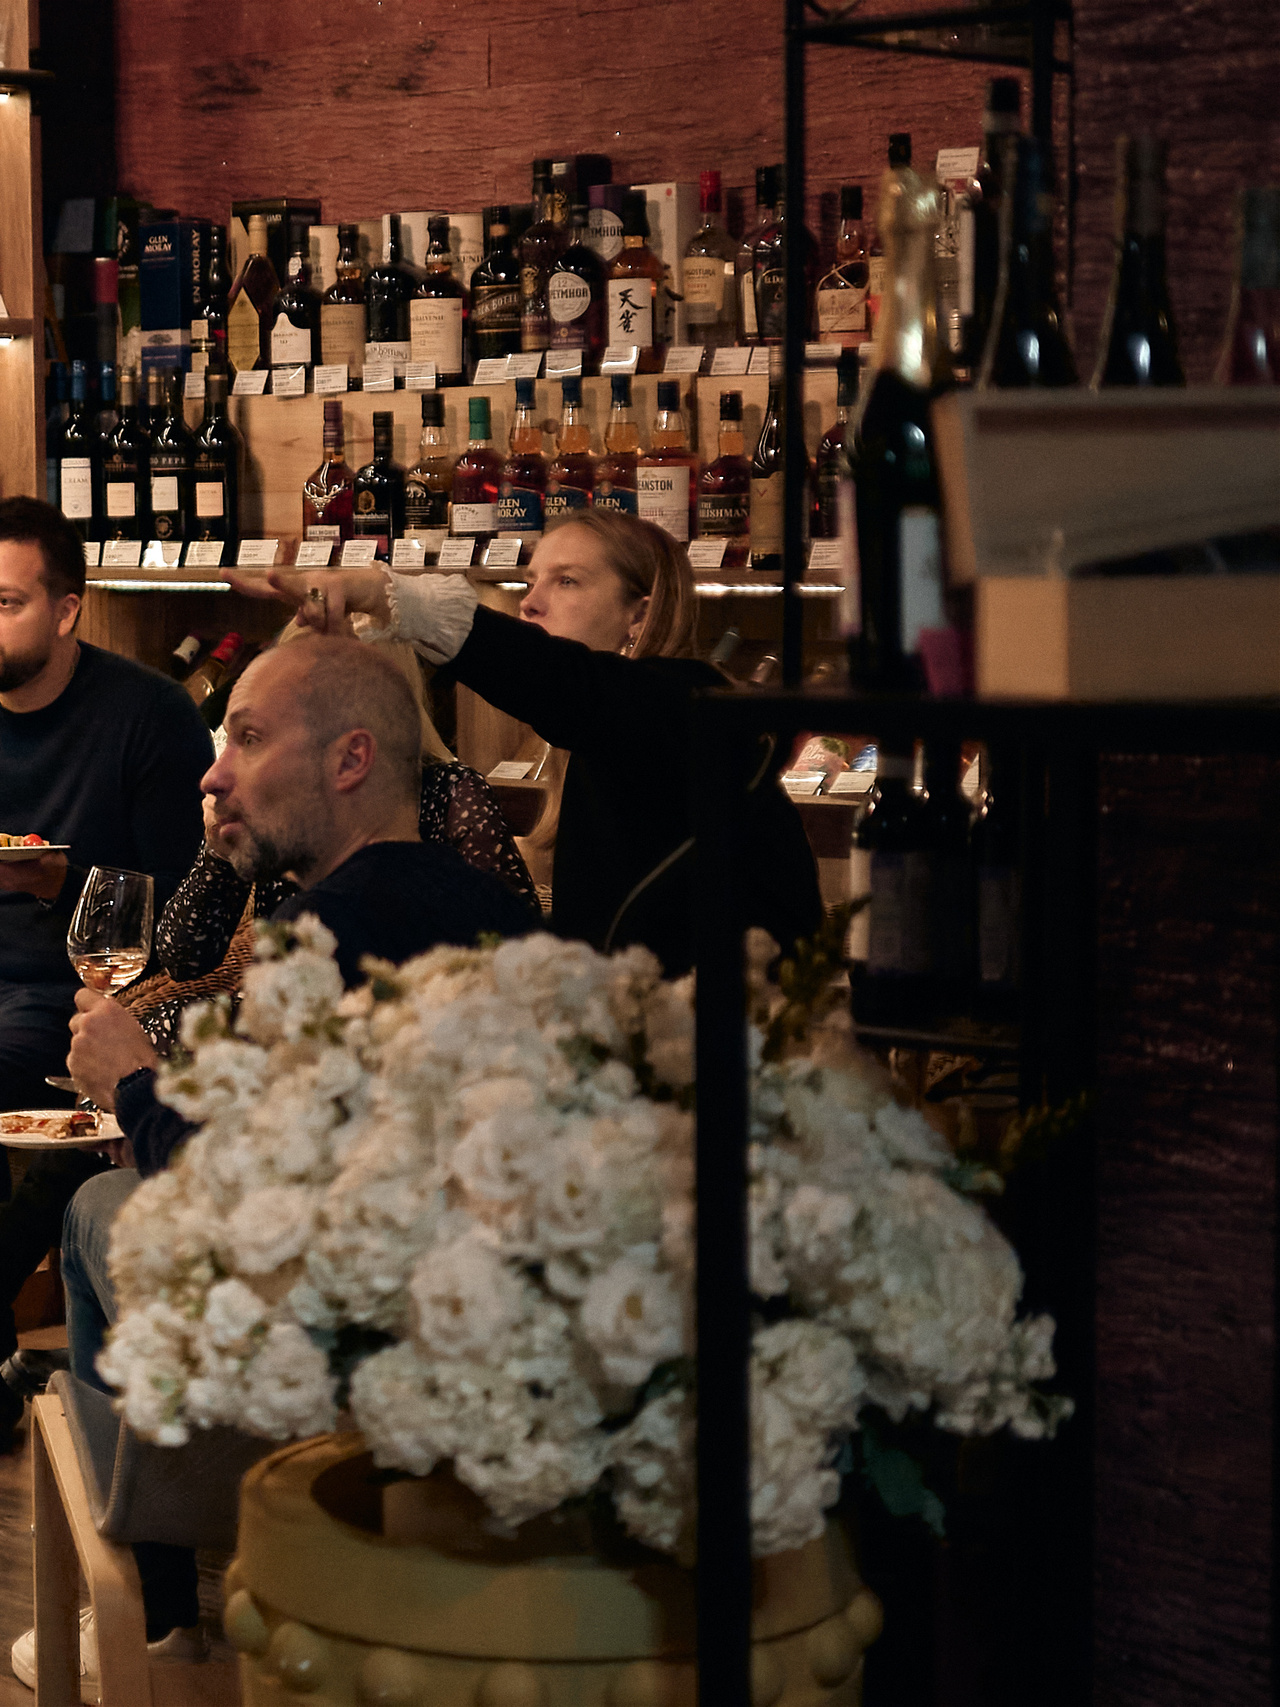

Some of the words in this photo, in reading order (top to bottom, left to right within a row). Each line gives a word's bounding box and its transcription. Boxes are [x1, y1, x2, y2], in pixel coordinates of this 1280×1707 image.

[148, 235, 168, 244] GLEN
[144, 242, 172, 253] MORAY
[192, 229, 201, 283] MORAY
